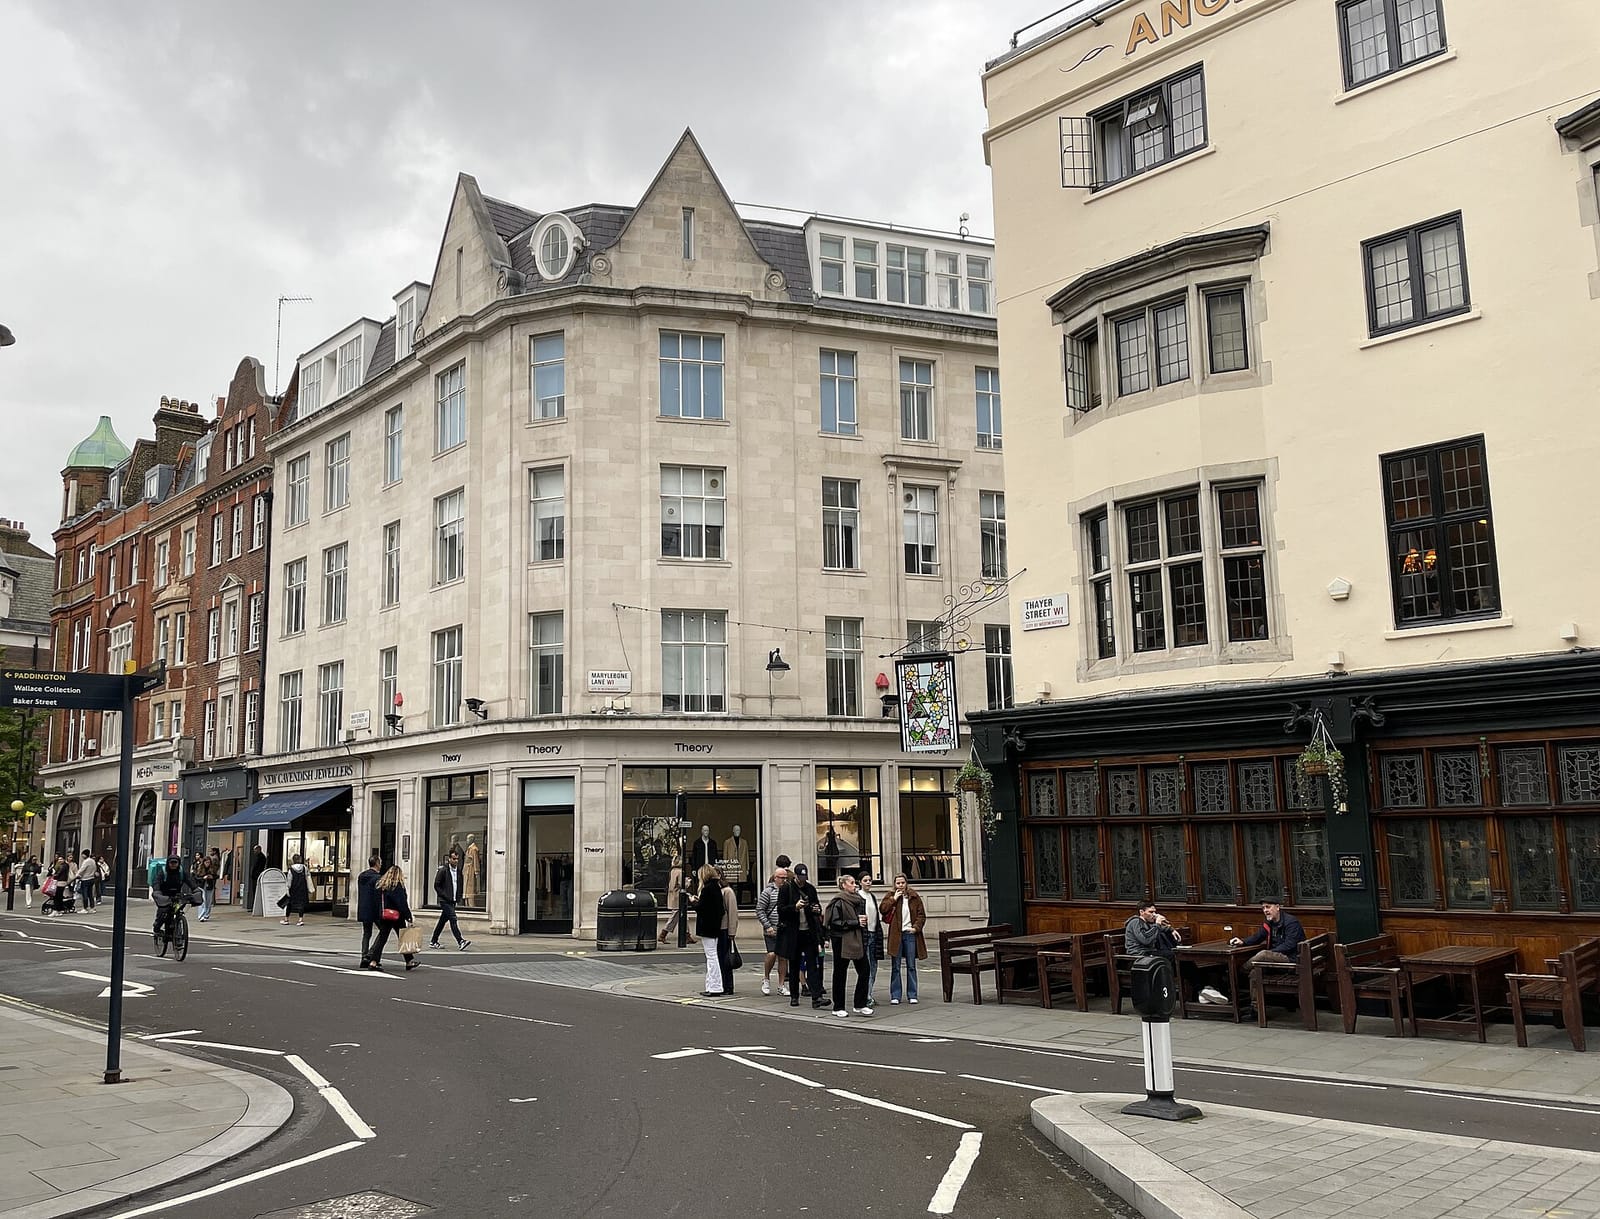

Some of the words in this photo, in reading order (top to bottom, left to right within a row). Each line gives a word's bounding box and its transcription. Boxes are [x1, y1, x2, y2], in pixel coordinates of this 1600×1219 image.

[1125, 0, 1240, 55] ANG
[1024, 598, 1053, 610] THAYER
[1025, 607, 1052, 620] STREET
[1053, 606, 1064, 616] W1
[14, 672, 66, 681] PADDINGTON
[14, 685, 43, 693] Wallace
[44, 686, 81, 694] Collection
[12, 697, 34, 705] Baker
[34, 698, 58, 706] Street
[526, 745, 562, 755] Theory
[674, 742, 713, 754] Theory
[442, 754, 462, 763] Theory
[263, 773, 277, 786] NEW
[278, 769, 313, 785] CAVENDISH
[314, 764, 353, 780] JEWELLERS
[200, 778, 216, 790] Sweaty
[216, 775, 228, 789] Betty
[1339, 859, 1361, 867] FOOD
[1162, 986, 1169, 998] 3
